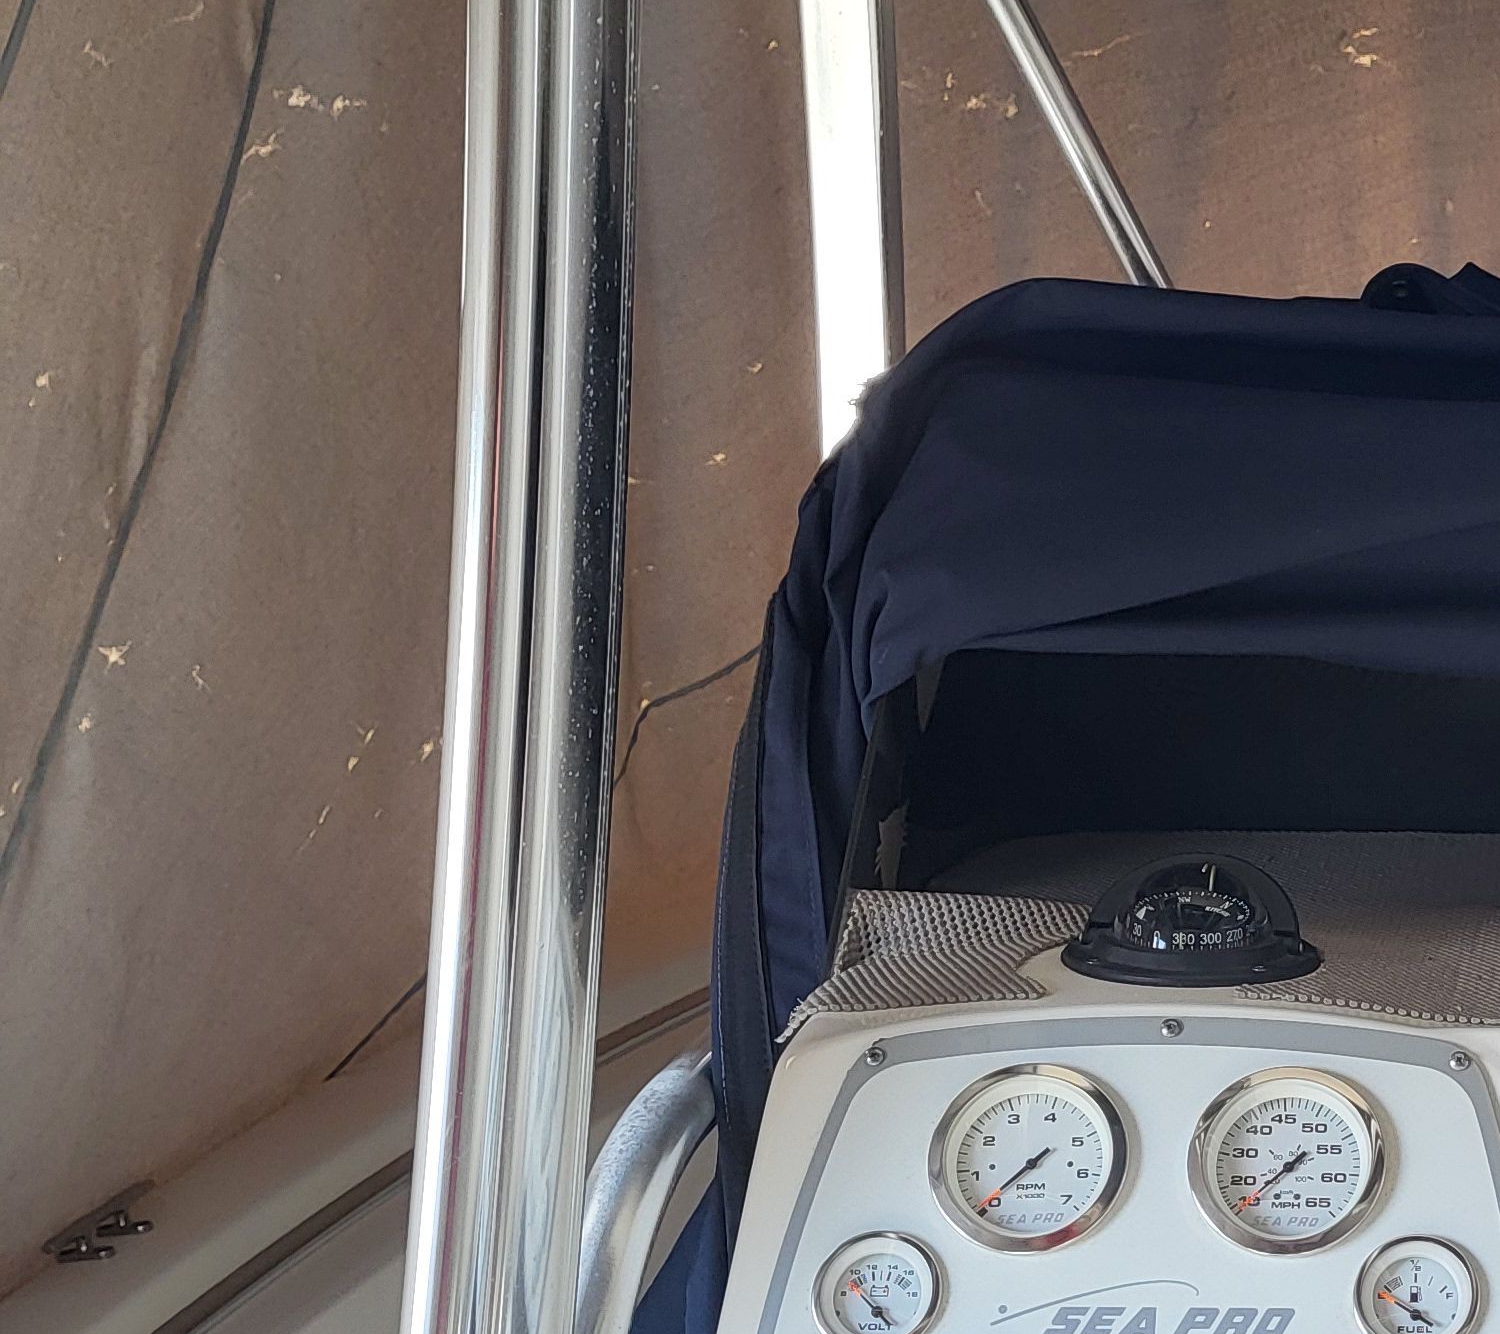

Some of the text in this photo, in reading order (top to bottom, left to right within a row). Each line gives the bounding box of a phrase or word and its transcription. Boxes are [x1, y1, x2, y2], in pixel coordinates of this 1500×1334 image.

[1200, 932, 1222, 945] 300
[1226, 928, 1244, 943] 270
[1007, 1114, 1020, 1124] 3
[1044, 1113, 1058, 1123] 4
[1271, 1114, 1297, 1124] 45
[1246, 1125, 1273, 1135] 40
[1302, 1123, 1328, 1133] 50
[982, 1136, 996, 1146] 2
[1072, 1137, 1083, 1147] 5
[1232, 1148, 1258, 1158] 30
[1316, 1144, 1342, 1154] 55
[971, 1171, 980, 1181] 1
[1077, 1169, 1089, 1179] 6
[1321, 1172, 1347, 1183] 60
[1230, 1175, 1257, 1186] 20
[1016, 1183, 1045, 1191] RPM
[988, 1197, 1001, 1208] 0
[1060, 1194, 1073, 1205] 7
[1305, 1197, 1331, 1208] 65
[1271, 1201, 1300, 1209] MPH
[999, 1212, 1064, 1225] SEA PRO
[1253, 1216, 1319, 1227] SEA PRO
[1446, 1292, 1454, 1300] F
[857, 1323, 893, 1331] VOLT
[1397, 1325, 1433, 1334] FUEL
